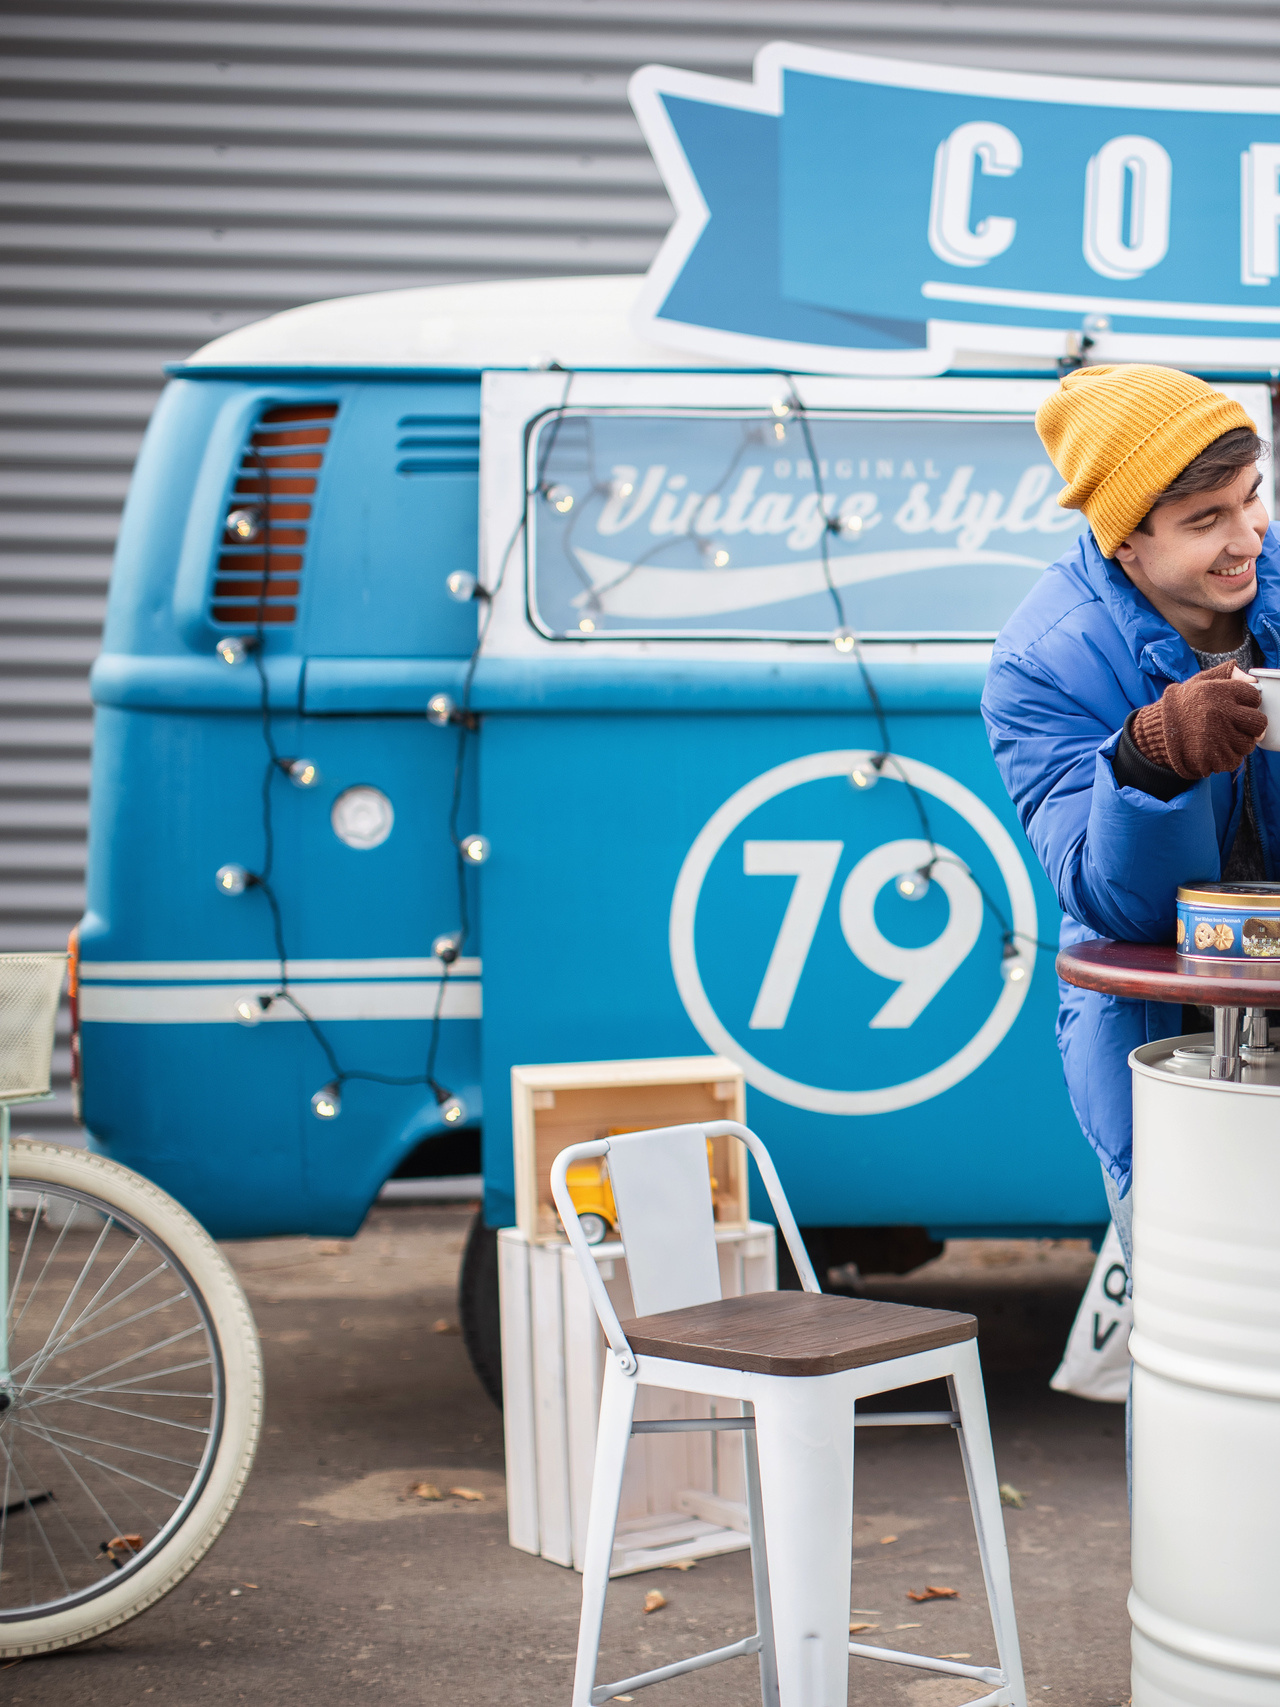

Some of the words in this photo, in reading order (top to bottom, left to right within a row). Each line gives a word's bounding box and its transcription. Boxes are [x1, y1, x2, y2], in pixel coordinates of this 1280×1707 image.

[596, 465, 882, 551] Vintage
[893, 464, 1082, 550] style
[773, 458, 941, 480] ORIGINAL
[743, 838, 984, 1030] 79
